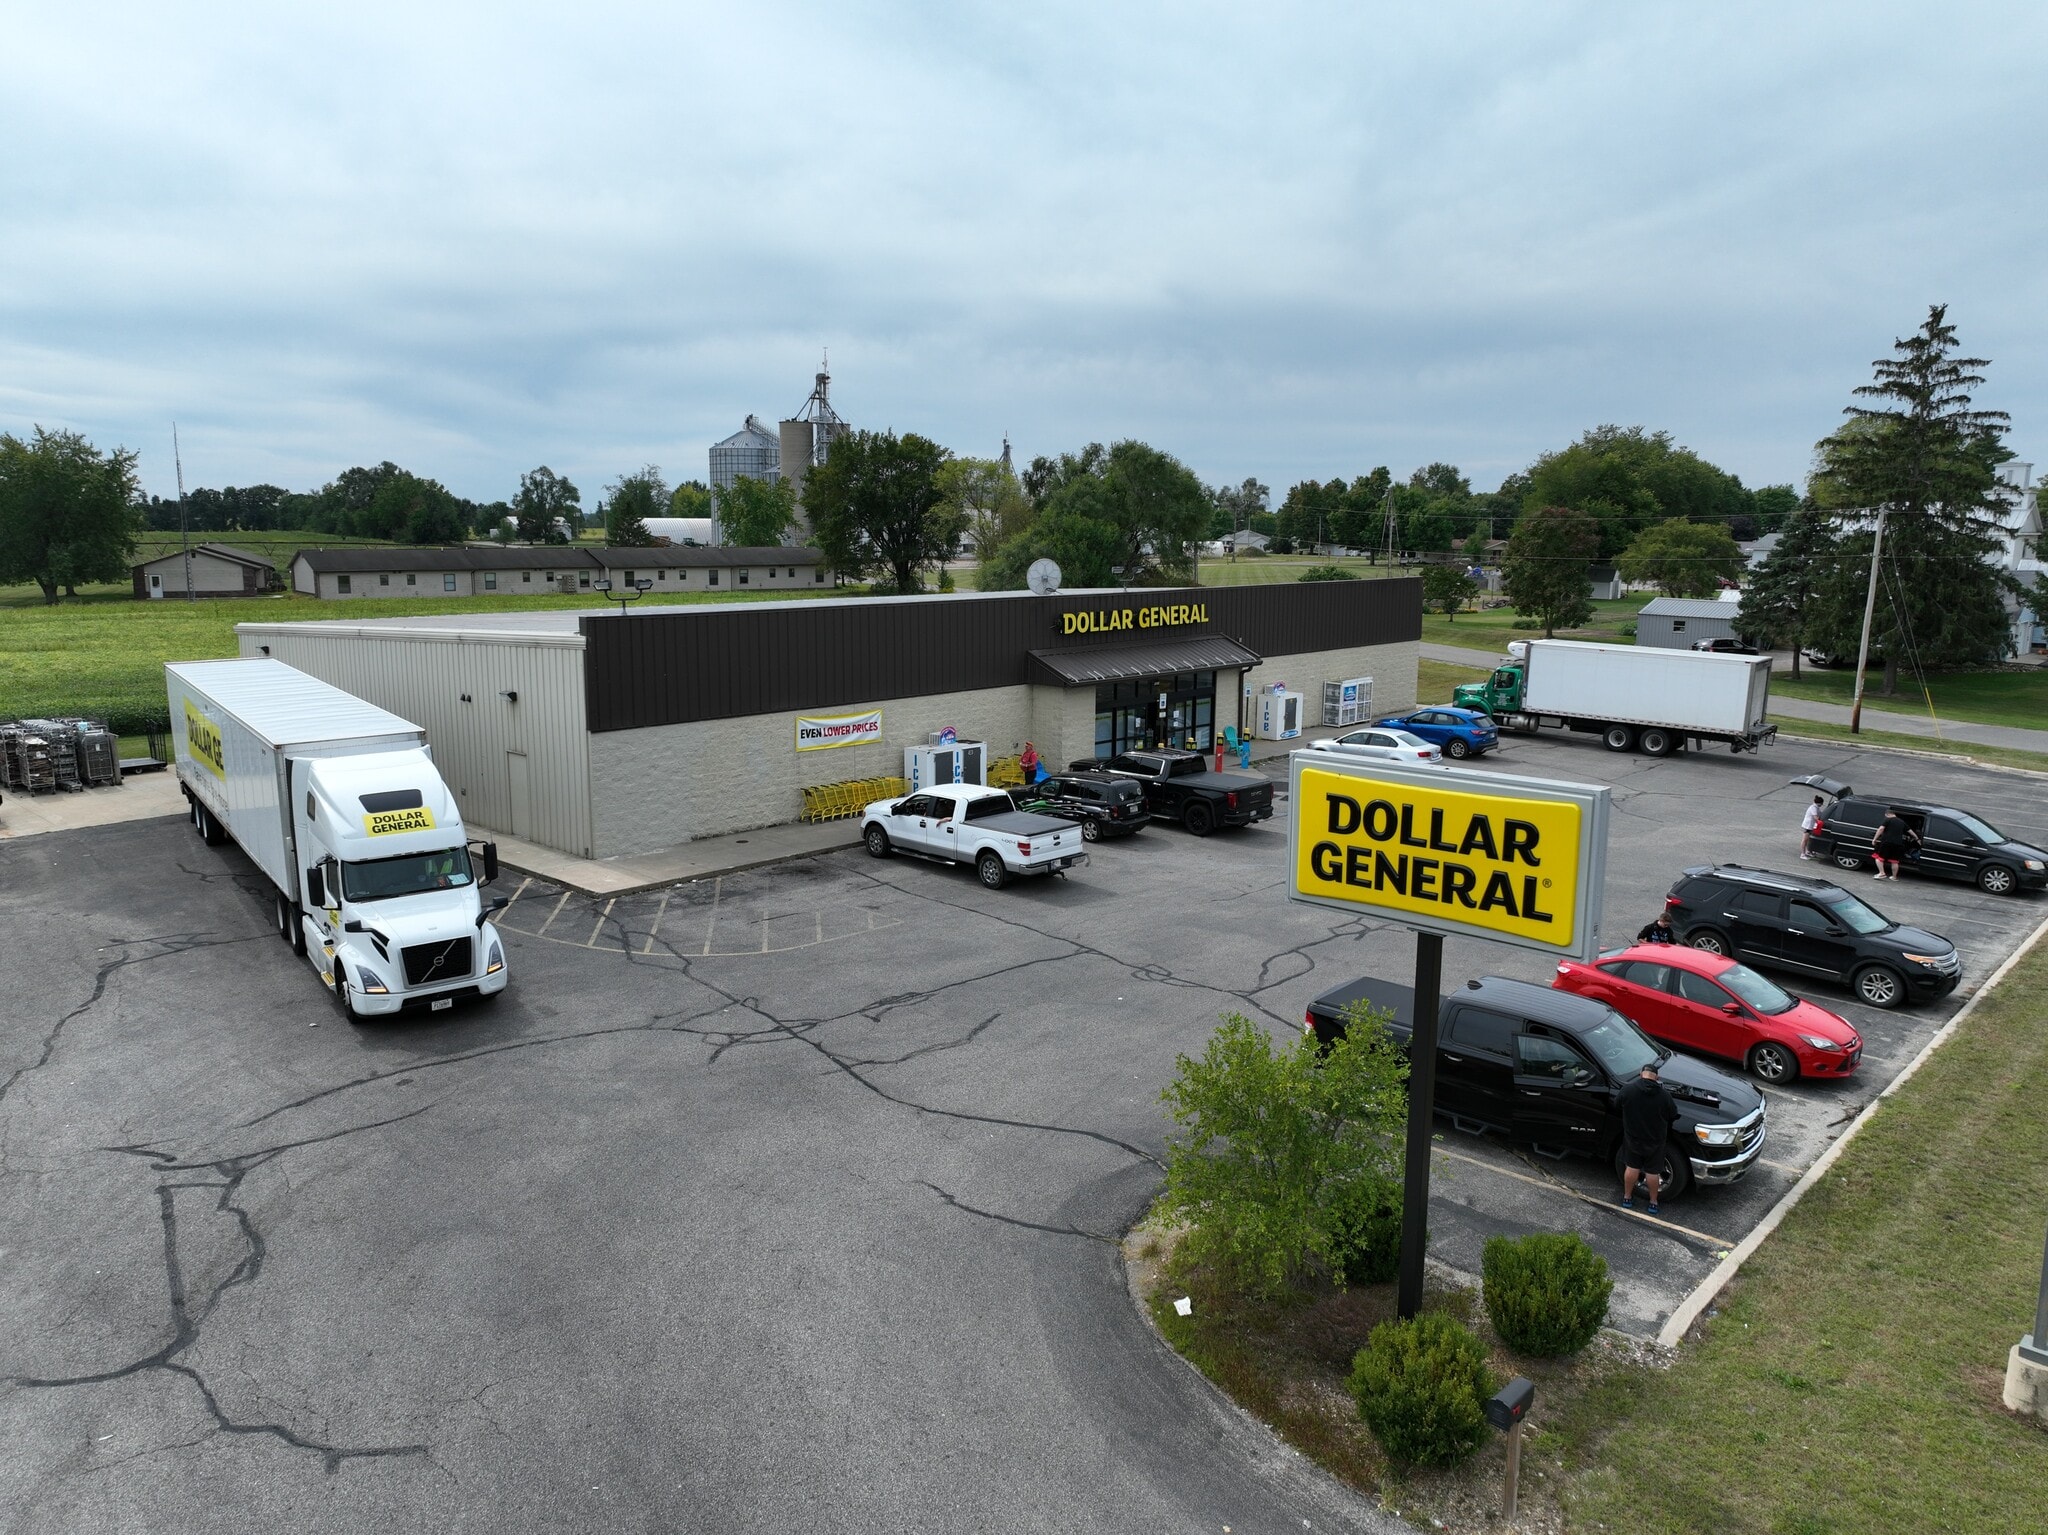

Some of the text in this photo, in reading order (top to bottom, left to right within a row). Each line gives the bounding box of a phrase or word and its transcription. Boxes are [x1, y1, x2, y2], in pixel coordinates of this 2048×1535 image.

[1063, 604, 1209, 634] DOLLAR GENERAL
[800, 721, 879, 739] EVEN LOWER PRICES
[372, 811, 424, 824] DOLLAR
[372, 819, 430, 833] GENERAL
[1326, 792, 1541, 867] DOLLAR
